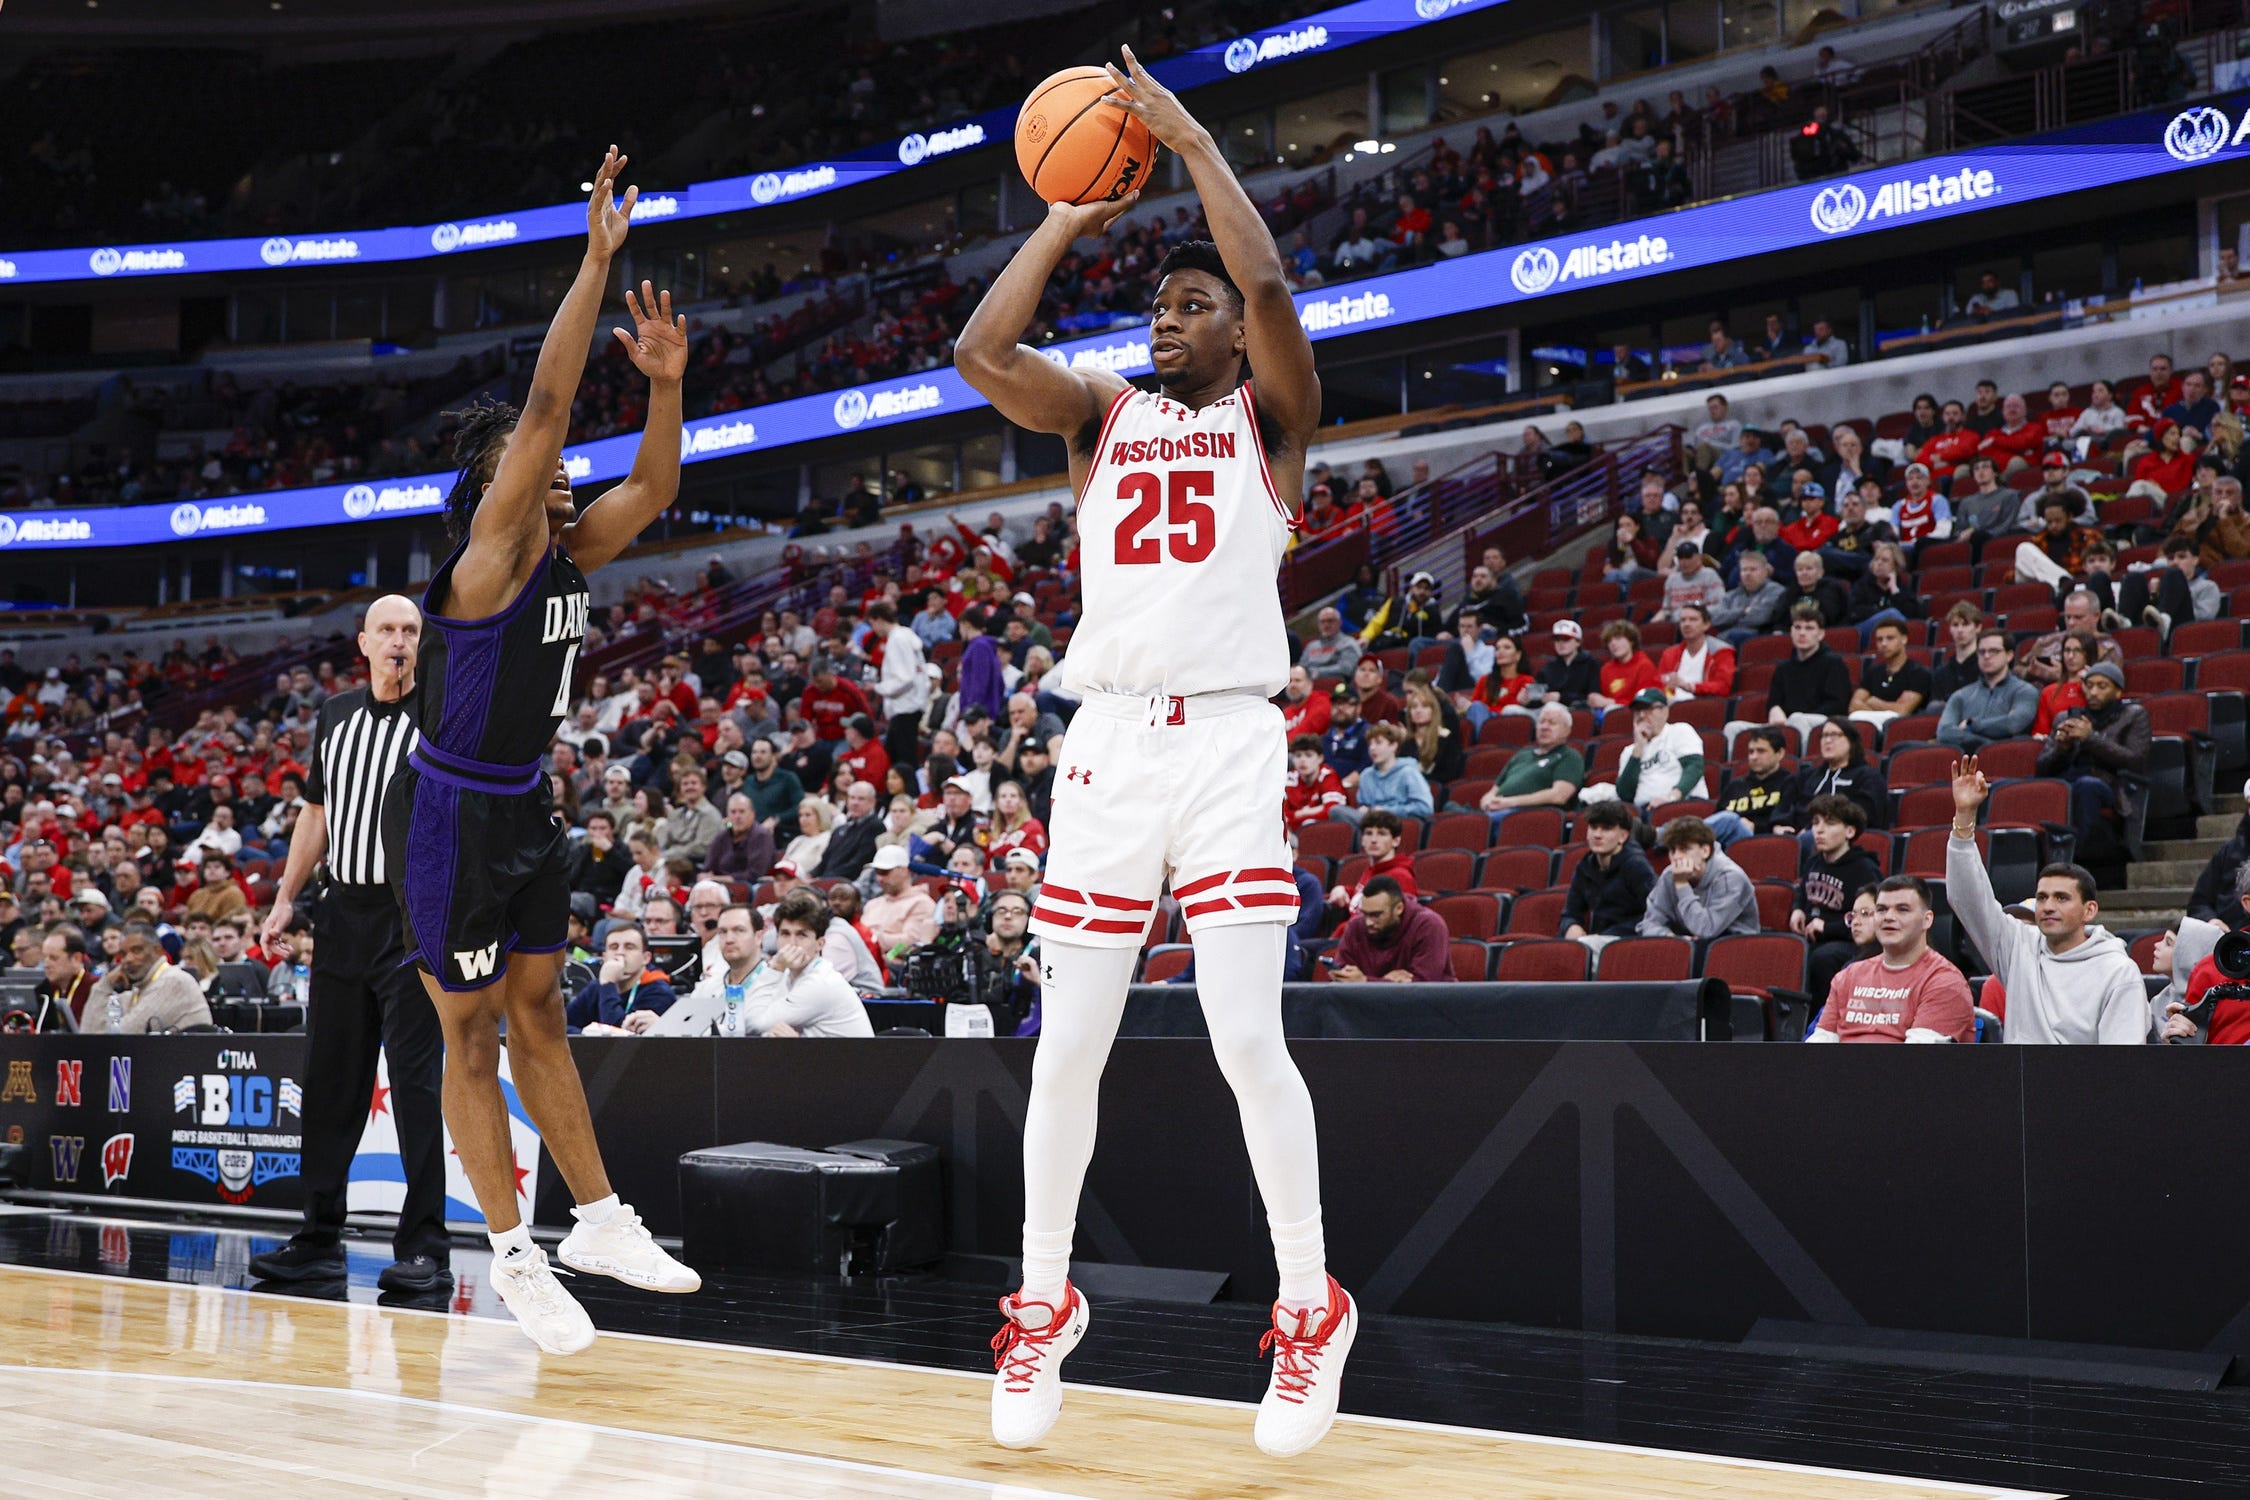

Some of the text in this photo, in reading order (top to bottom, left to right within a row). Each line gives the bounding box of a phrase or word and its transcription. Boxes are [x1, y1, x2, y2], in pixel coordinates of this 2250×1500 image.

[1257, 26, 1327, 61] Allstate
[924, 125, 984, 156] Allstate
[780, 167, 836, 197] Allstate
[1867, 168, 1995, 221] Allstate
[460, 221, 517, 245] Allstate
[120, 250, 185, 271] Allstate
[292, 239, 358, 260] Allstate
[1559, 235, 1668, 282] Allstate
[1301, 291, 1390, 332] Allstate
[1071, 341, 1150, 371] Allstate
[867, 384, 941, 420] Allstate
[690, 422, 755, 454] Allstate
[1110, 432, 1236, 466] WSCONSIN
[375, 484, 441, 511] Allstate
[16, 518, 90, 541] Allstate
[201, 504, 265, 530] Allstate
[1115, 471, 1216, 565] 25
[453, 940, 499, 981] W
[230, 1050, 257, 1070] TIAA
[56, 1060, 83, 1106] N
[108, 1056, 131, 1113] N
[197, 1130, 247, 1146] BASKETBALL
[247, 1132, 302, 1149] TOURNAMENT
[51, 1136, 84, 1182] W
